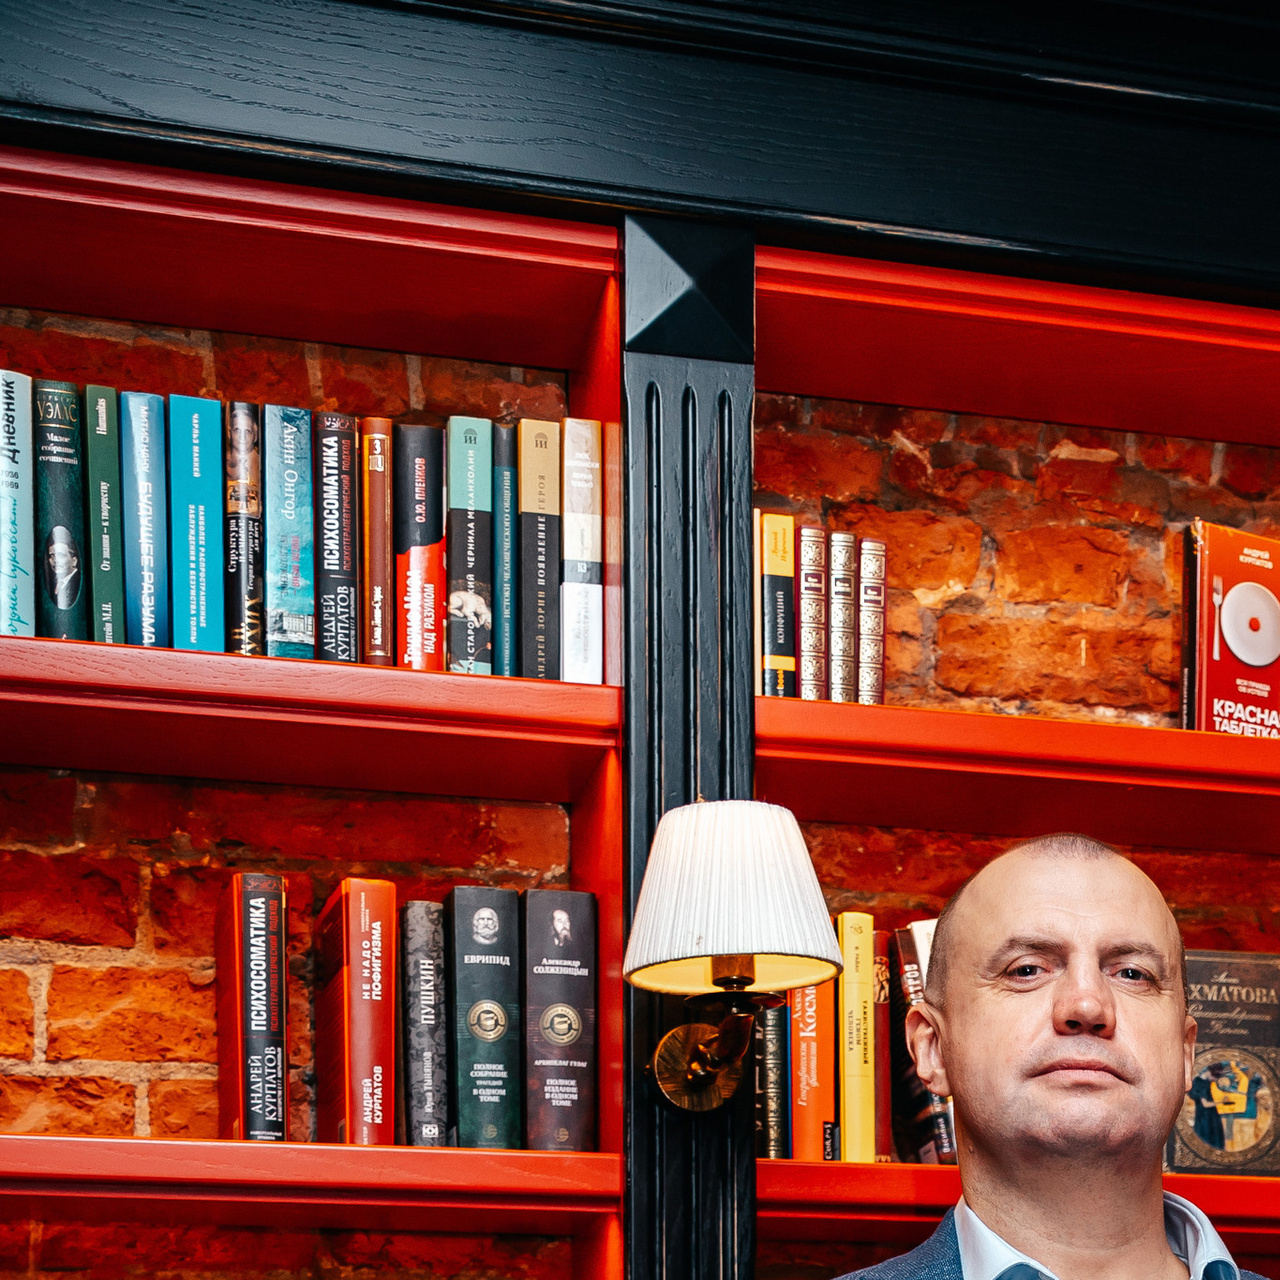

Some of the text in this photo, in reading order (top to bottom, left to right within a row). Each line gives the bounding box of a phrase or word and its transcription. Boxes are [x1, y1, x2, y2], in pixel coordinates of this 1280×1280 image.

[1, 378, 20, 463] Дневник
[37, 399, 77, 420] УЭЛЛС
[46, 432, 71, 444] Малое
[95, 397, 108, 433] Humanitas
[39, 454, 78, 464] сочинений
[190, 413, 200, 478] ЧАРЛЬЗ МАККЕЙ
[280, 421, 297, 520] Акин Онгор
[321, 434, 340, 569] ПСИХОСОМАТИКА
[340, 438, 352, 570] ПСИХОТЕРАПЕВТИЧЕСКИЙ ПОДХОД
[415, 456, 426, 521] О.Ю. ПЛЕНКОВ
[467, 448, 475, 567] ЧЕРНИЛА МЕЛАНХОЛИИ
[537, 473, 546, 509] ГЕРОЯ
[136, 406, 154, 644] МИТИО КАКУ БУДУЩЕЕ РАЗУМА
[187, 504, 195, 561] ЗАБЛУЖДЕНИЯ
[228, 518, 239, 572] Структура
[537, 515, 546, 584] ПОЯВЛЕНИЕ
[102, 600, 112, 620] М.Н.
[197, 547, 205, 628] РАСПРОСТРАНЕННЫЕ
[424, 582, 436, 652] НАД РАЗУМОМ
[537, 589, 546, 628] ЗОРИН
[188, 617, 196, 644] ТОЛПЫ
[321, 593, 336, 652] АНДРЕЙ
[336, 584, 351, 659] КУРПАТОВ
[776, 591, 785, 644] КОНФУЦИЙ
[536, 633, 546, 678] АНДРЕЙ
[249, 896, 267, 1030] ПСИХОСОМАТИКА
[269, 898, 280, 1030] ПСИХОТЕРАПЕВТИЧЕСКИЙ ПОДХОД
[362, 938, 371, 998] НЕ НАДО
[371, 920, 382, 999] ПОФИГИЗМА
[464, 955, 510, 966] ЕВРИПИД
[533, 965, 588, 977] СОЛЖЕНИЦЫН
[541, 957, 581, 968] Александр
[420, 958, 436, 1024] ПУШКИН
[247, 1054, 263, 1113] АНДРЕЙ
[264, 1045, 278, 1120] КУРПАТОВ
[423, 1050, 434, 1111] Юрий ТЫНЯНОВ
[470, 1070, 508, 1078] СОБРАНИЕ
[473, 1063, 504, 1071] ПОЛНОЕ
[544, 1085, 578, 1093] ИЗДАНИЕ
[546, 1078, 577, 1086] ПОЛНОЕ
[797, 1040, 809, 1105] Географические
[808, 1040, 820, 1086] фантазии
[362, 1077, 373, 1122] АНДРЕЙ
[373, 1064, 383, 1123] КУРПАТОВ
[479, 1095, 500, 1103] ТОМЕ
